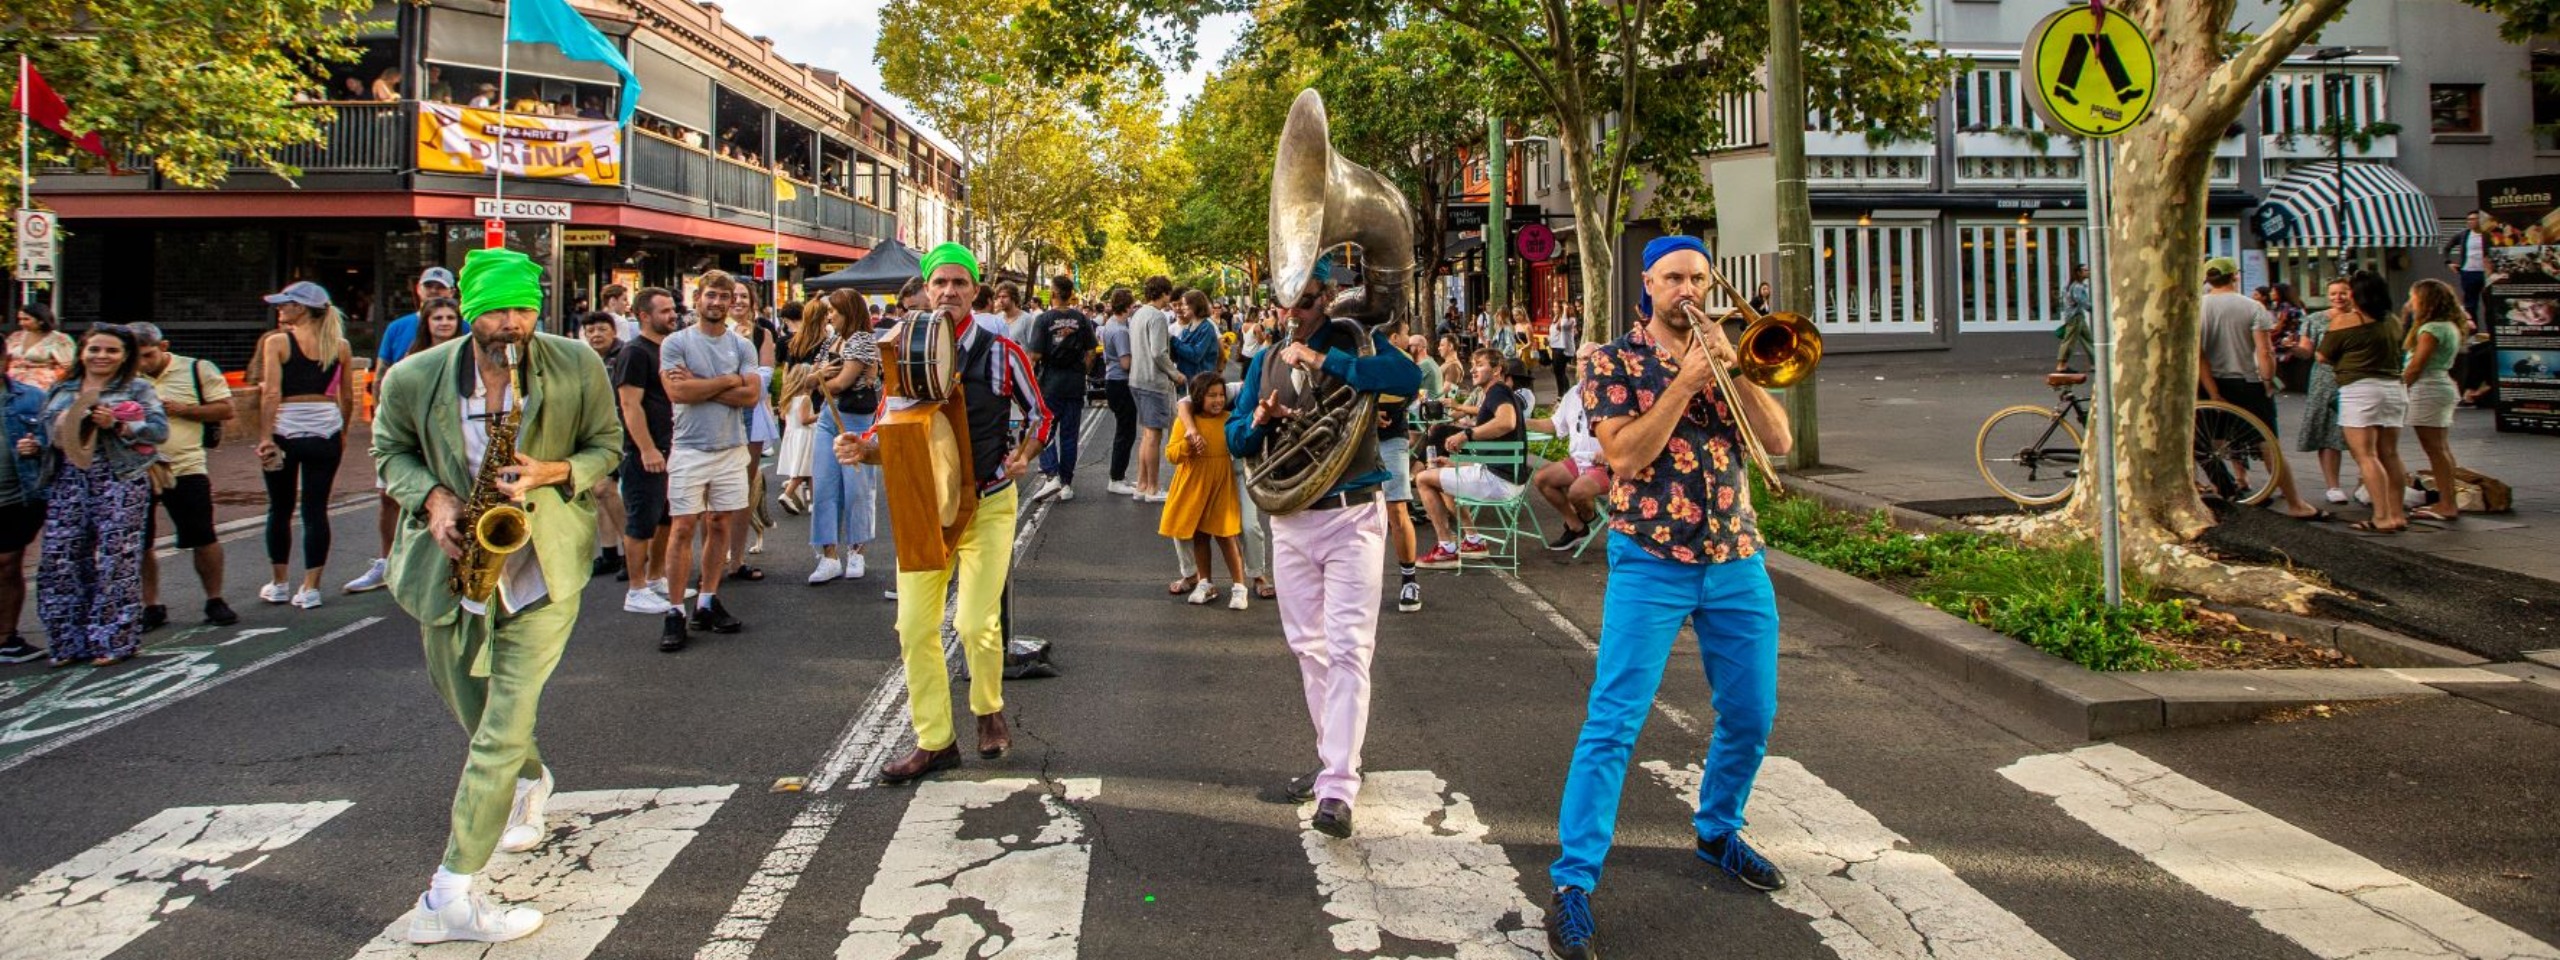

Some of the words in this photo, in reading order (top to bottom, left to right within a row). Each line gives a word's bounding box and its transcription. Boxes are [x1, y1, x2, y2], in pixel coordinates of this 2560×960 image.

[523, 128, 553, 140] HAVE
[557, 131, 566, 141] A
[2490, 192, 2552, 205] antenna
[480, 201, 511, 214] THE
[515, 202, 568, 217] CLOCK
[464, 226, 518, 240] Telene
